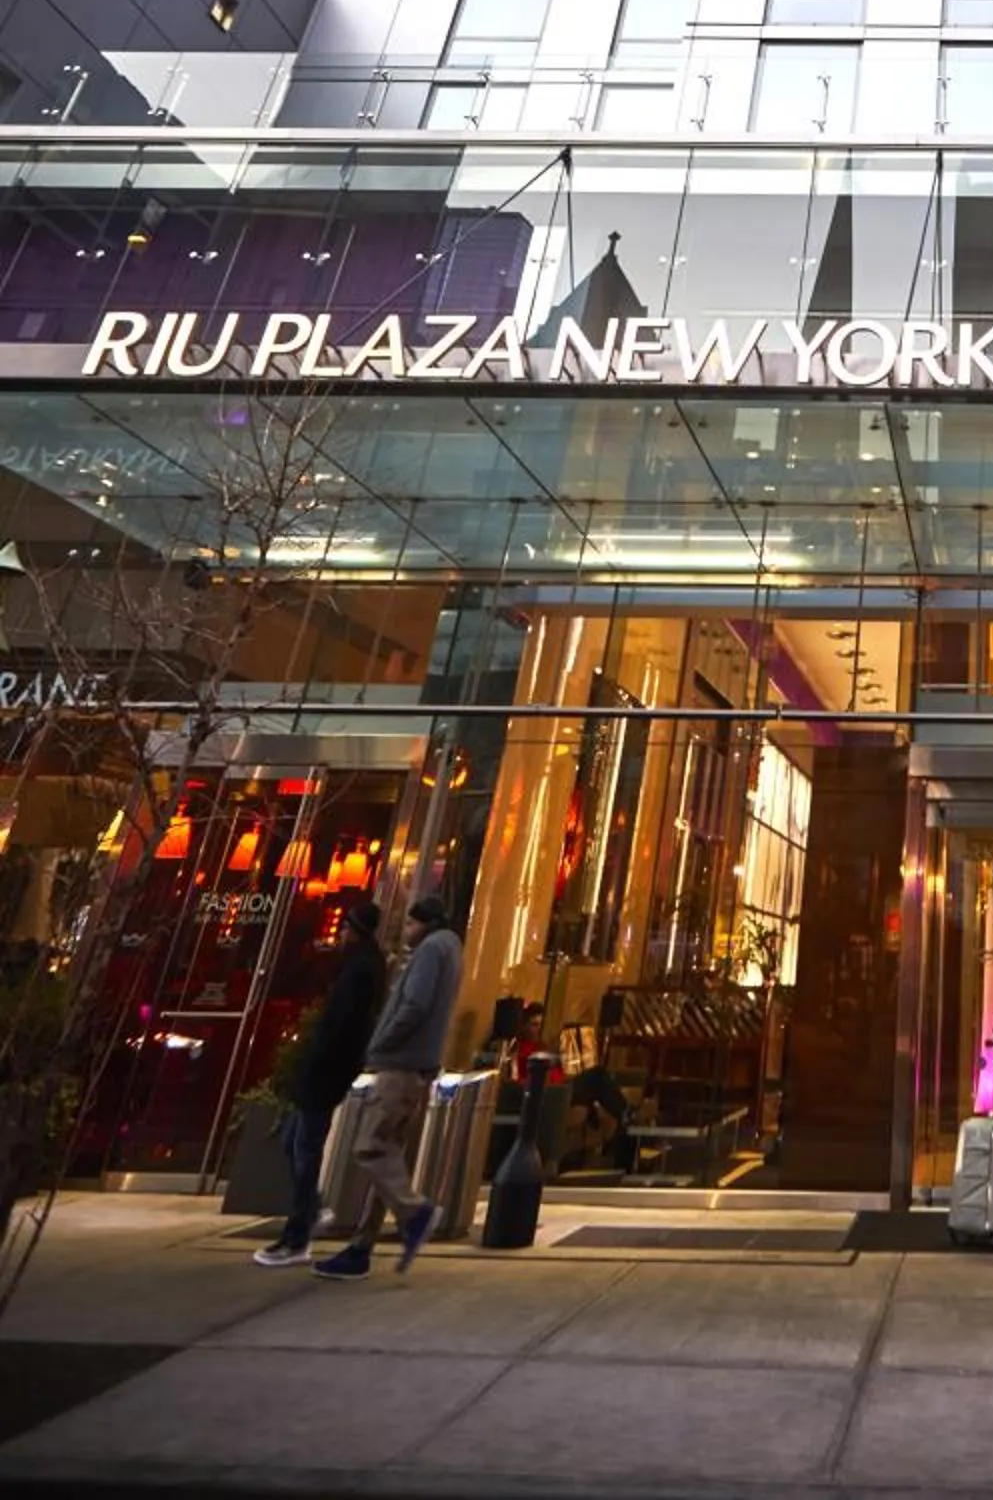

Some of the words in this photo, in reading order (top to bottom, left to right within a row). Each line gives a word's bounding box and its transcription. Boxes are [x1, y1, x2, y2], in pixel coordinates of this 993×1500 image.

[81, 311, 239, 378] RIU
[251, 312, 528, 380] PLAZA
[548, 316, 766, 384] NEW
